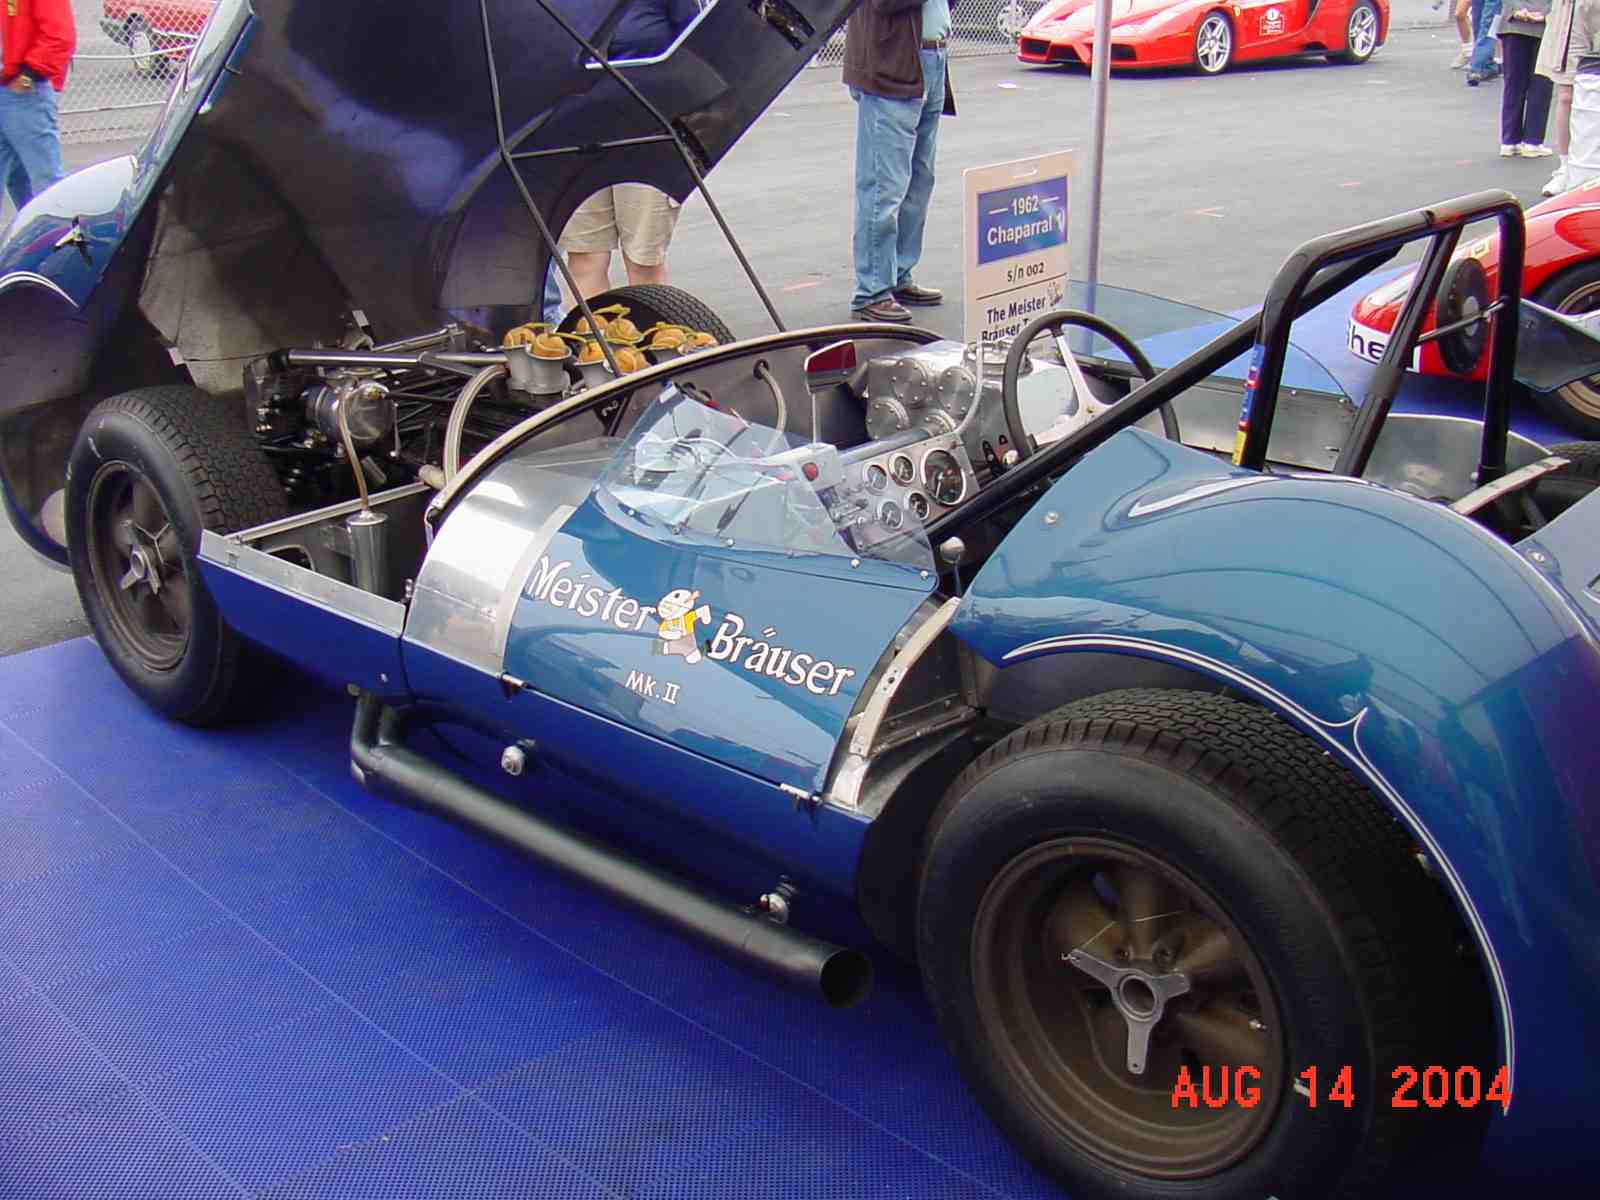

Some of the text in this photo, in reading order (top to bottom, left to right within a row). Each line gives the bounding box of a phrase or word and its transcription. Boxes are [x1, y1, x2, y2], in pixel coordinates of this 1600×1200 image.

[1011, 195, 1039, 216] 1962
[987, 215, 1052, 246] Chaparral
[1026, 262, 1045, 277] 002
[987, 307, 1006, 324] The
[1008, 296, 1046, 318] Meister
[527, 555, 658, 633] Meister
